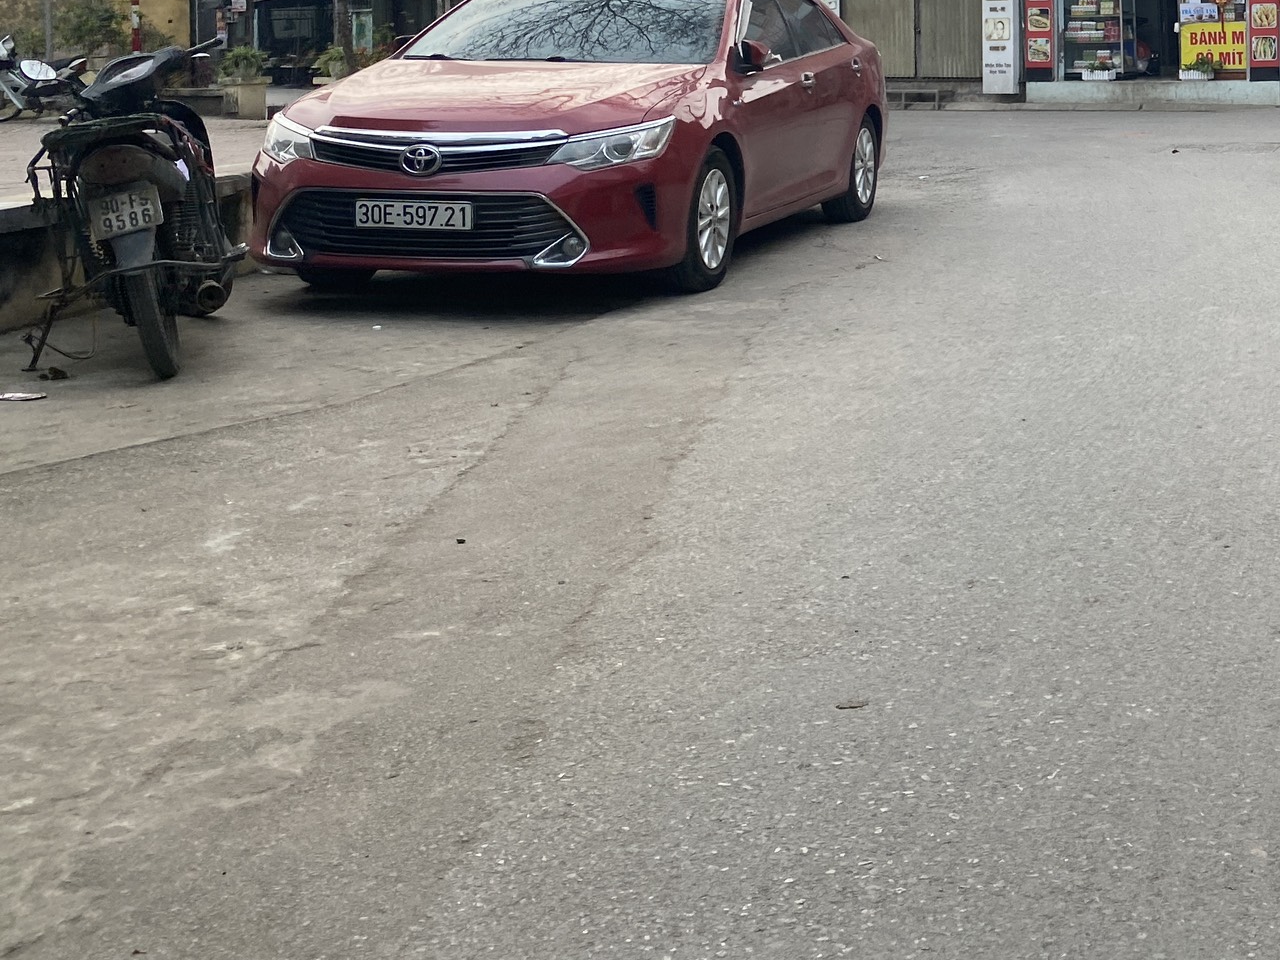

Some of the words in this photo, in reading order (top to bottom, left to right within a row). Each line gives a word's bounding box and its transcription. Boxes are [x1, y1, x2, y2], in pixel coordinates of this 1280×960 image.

[1190, 29, 1227, 46] BÁNH
[1195, 49, 1214, 63] CÔ
[1218, 49, 1244, 66] MÍT
[103, 207, 152, 234] 9586
[358, 203, 466, 228] 30E-597.21
